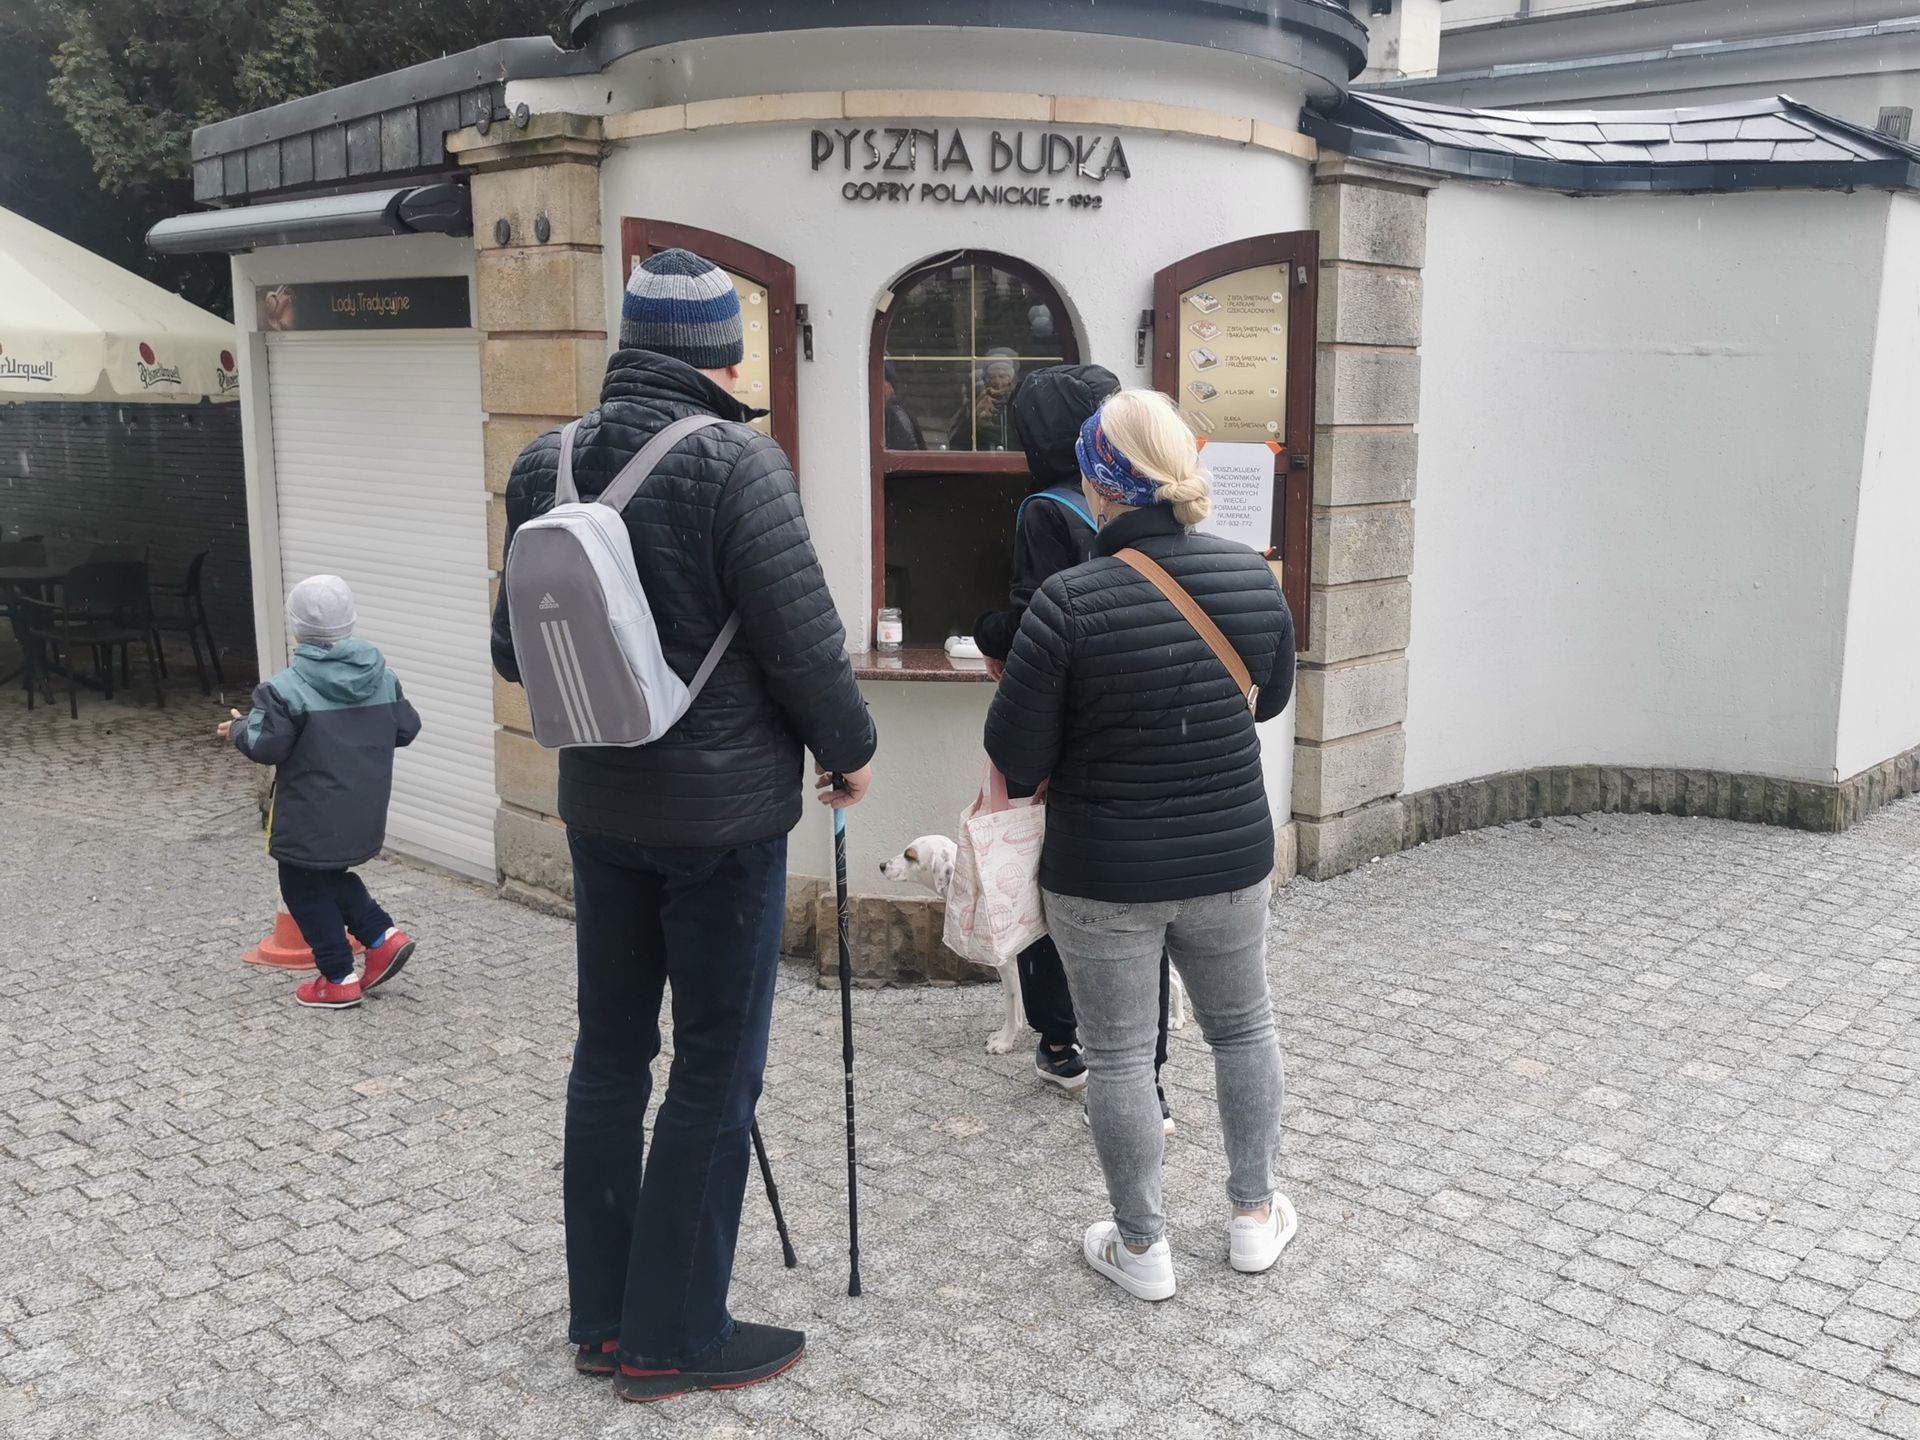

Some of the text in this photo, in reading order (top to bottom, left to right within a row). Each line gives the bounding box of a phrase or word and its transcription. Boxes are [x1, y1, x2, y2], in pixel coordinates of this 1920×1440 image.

[811, 127, 1132, 181] PYSZNA BUDKA
[841, 181, 915, 203] GOFRY
[921, 184, 1051, 207] POLANICKIE
